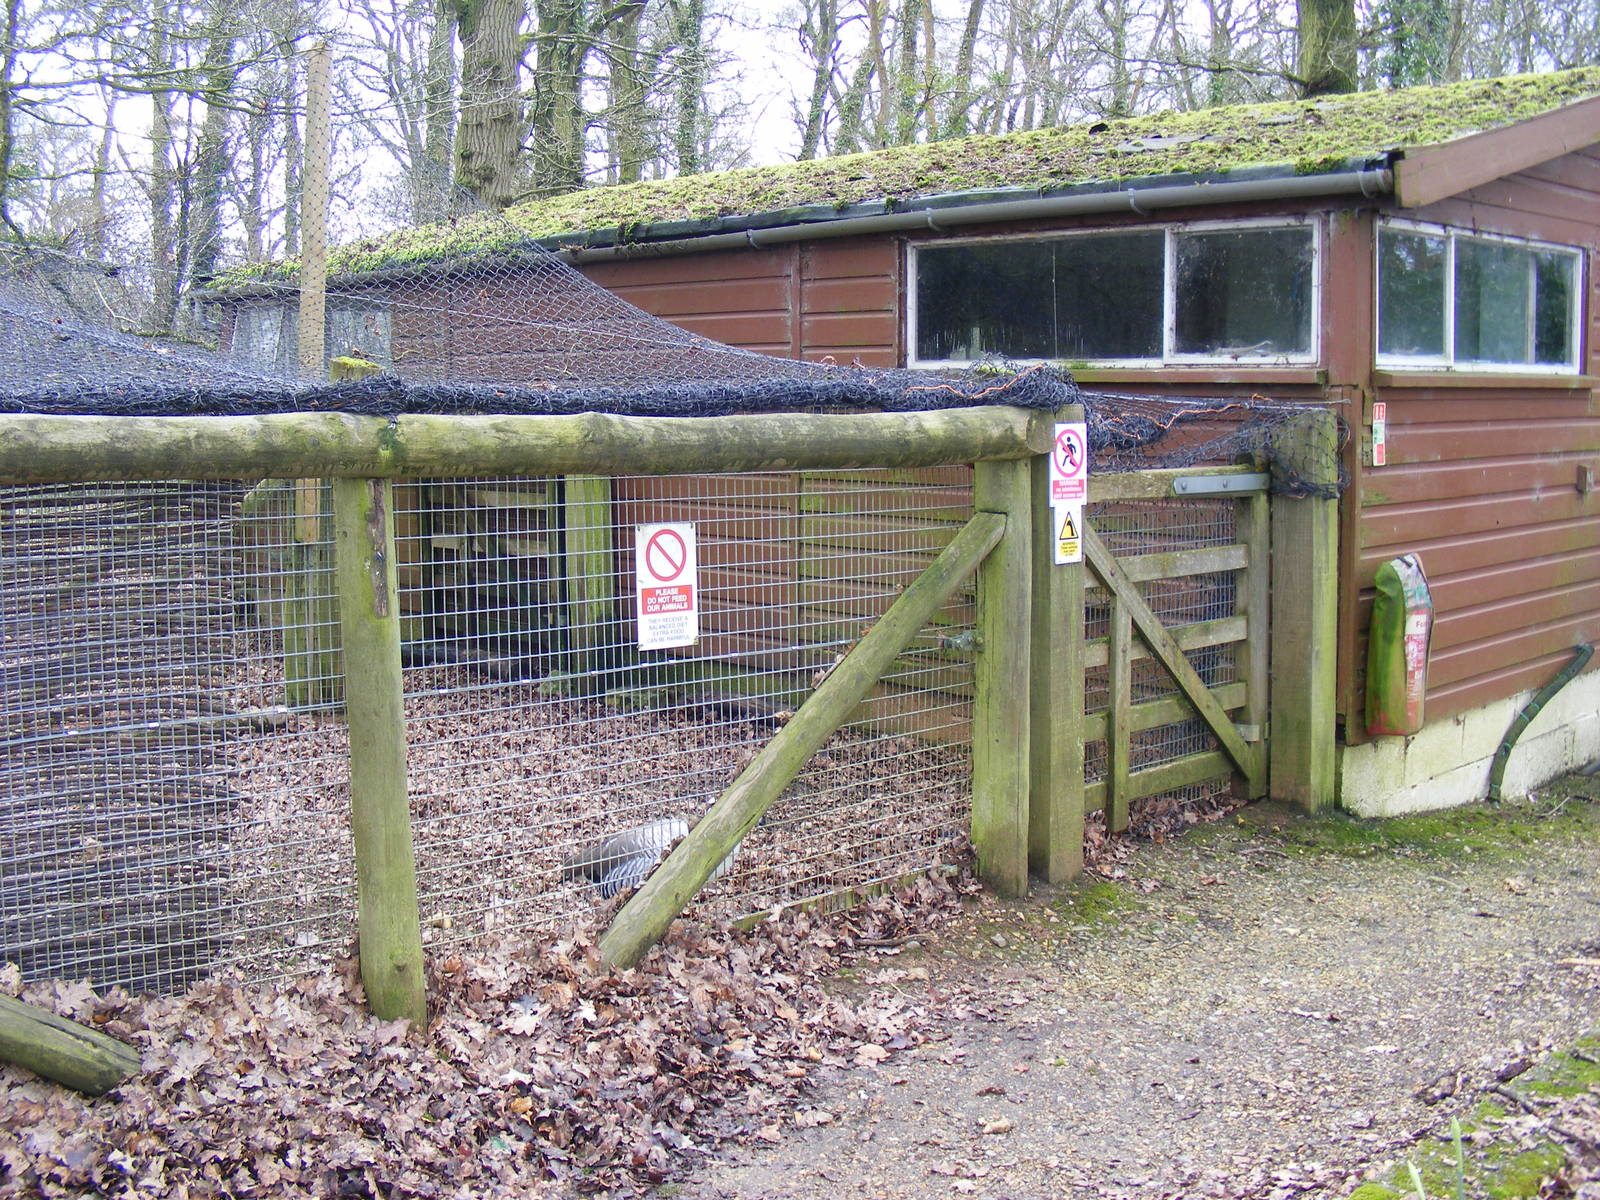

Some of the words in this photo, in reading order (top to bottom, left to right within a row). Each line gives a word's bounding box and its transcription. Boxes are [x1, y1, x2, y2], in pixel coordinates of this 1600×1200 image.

[656, 587, 679, 596] PLEASE
[657, 596, 670, 604] NOT
[647, 604, 661, 612] OUR
[662, 602, 688, 611] ANIMALS
[663, 615, 683, 623] RECEIVE
[649, 623, 676, 631] BALANCED
